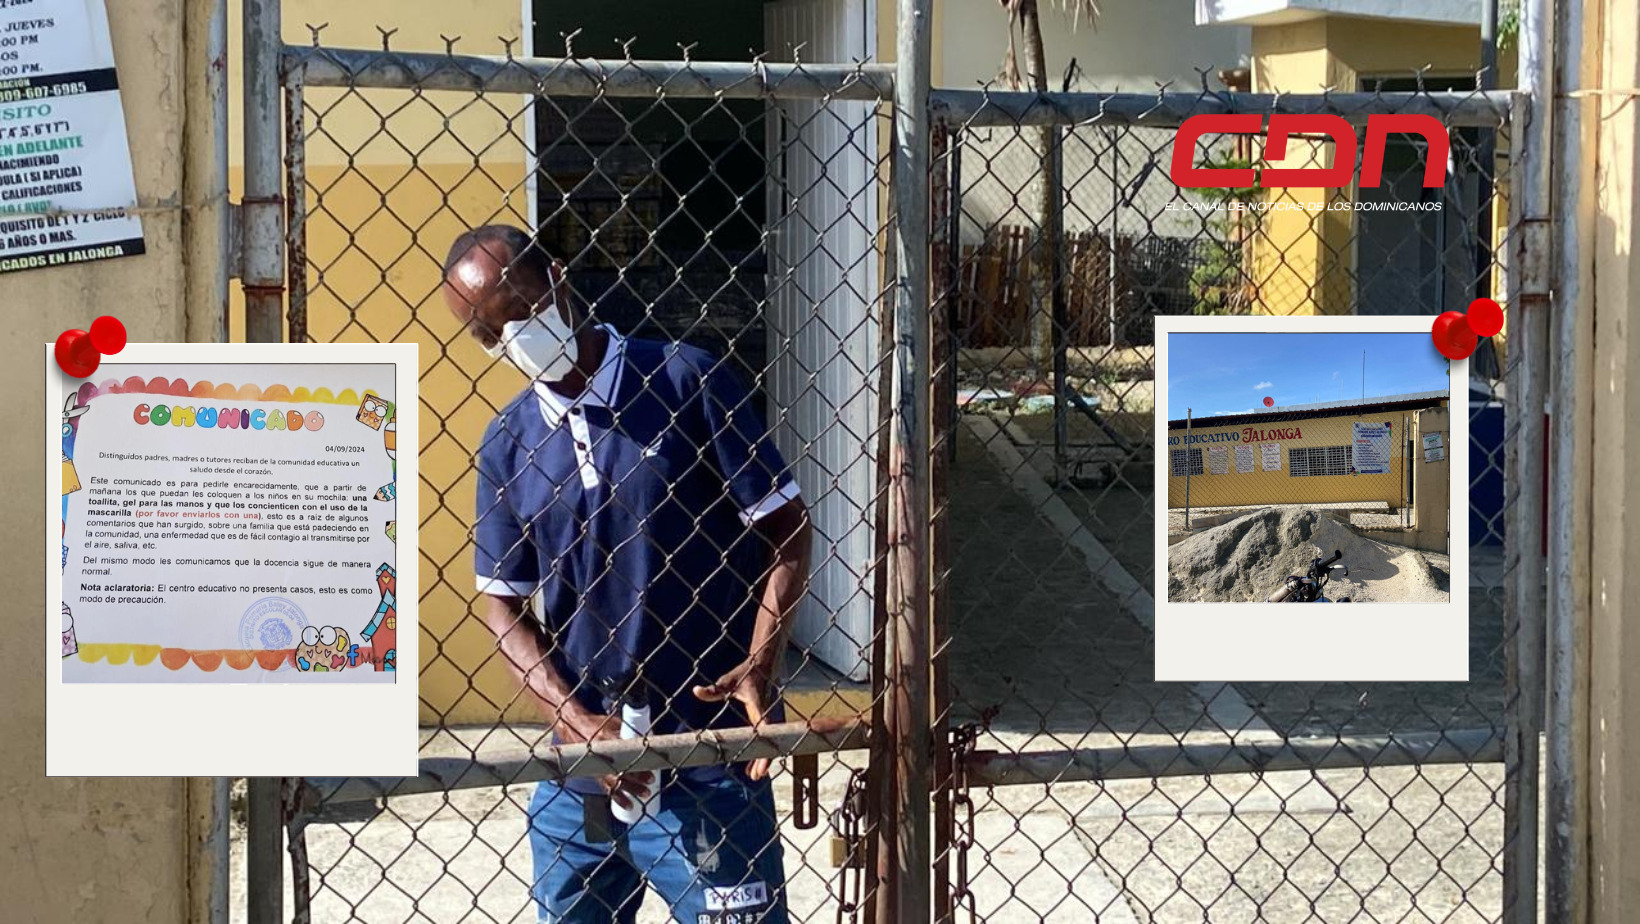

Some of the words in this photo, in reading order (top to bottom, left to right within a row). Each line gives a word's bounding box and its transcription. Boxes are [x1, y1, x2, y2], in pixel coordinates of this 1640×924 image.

[4, 18, 55, 32] JUEVES
[21, 34, 38, 46] PM
[0, 104, 52, 120] SITO
[17, 136, 83, 154] ADELANTE
[31, 171, 41, 182] SI
[43, 166, 82, 180] APLICA)
[2, 182, 83, 201] CALIFICACIONES
[0, 216, 45, 234] QUISITO
[8, 234, 37, 249] AÑOS
[49, 230, 77, 244] MAS.
[0, 255, 46, 272] CADOS
[49, 252, 67, 265] EN
[68, 245, 124, 263] JALONGA
[133, 403, 325, 432] COMUNICADO
[1242, 427, 1303, 443] JALONGA
[325, 445, 365, 453] 04/09/2024
[99, 452, 142, 463] Distinguidos
[171, 454, 198, 462] madres
[206, 455, 232, 463] tutores
[232, 455, 258, 464] reciban
[260, 456, 268, 465] de
[270, 456, 276, 465] la
[278, 457, 315, 466] comunidad
[317, 458, 349, 467] educativa
[190, 466, 212, 474] saludo
[214, 466, 235, 474] desde
[236, 466, 242, 475] el
[90, 476, 108, 485] Este
[113, 477, 162, 486] comunicado
[180, 480, 198, 489] para
[203, 479, 229, 490] pedirle
[304, 484, 318, 492] que
[333, 482, 352, 493] partir
[356, 483, 366, 491] de
[89, 487, 121, 496] mañana
[126, 488, 137, 496] los
[140, 490, 156, 499] que
[160, 489, 189, 499] puedan
[192, 489, 204, 498] les
[206, 490, 242, 500] coloquen
[252, 491, 264, 499] los
[268, 491, 288, 500] niños
[122, 498, 136, 509] gel
[139, 501, 158, 509] para
[160, 499, 173, 507] las
[214, 502, 230, 510] que
[233, 500, 245, 509] los
[248, 501, 301, 510] concienticen
[320, 502, 327, 510] el
[348, 503, 358, 511] de
[360, 503, 368, 511] la
[88, 508, 132, 517] mascarilla
[136, 509, 153, 519] (por
[157, 509, 179, 518] favor
[182, 510, 220, 519] enviarlos
[267, 512, 284, 520] esto
[324, 513, 335, 521] de
[338, 513, 368, 523] algunos
[86, 519, 136, 527] comentarios
[138, 521, 154, 530] que
[156, 520, 172, 528] han
[208, 521, 230, 529] sobre
[250, 521, 274, 530] familia
[276, 524, 291, 532] que
[294, 522, 310, 531] está
[312, 523, 358, 533] padeciendo
[86, 529, 93, 537] la
[161, 530, 209, 539] enfermedad
[210, 533, 226, 541] que
[238, 531, 248, 540] de
[250, 532, 266, 540] fácil
[268, 532, 301, 542] contagio
[302, 532, 309, 541] al
[311, 533, 355, 541] transmitirse
[356, 535, 370, 543] por
[84, 541, 92, 549] el
[142, 541, 157, 549] etc.
[83, 556, 97, 564] Del
[101, 556, 128, 564] mismo
[132, 556, 156, 565] modo
[160, 557, 171, 565] les
[175, 557, 230, 566] comunicamos
[234, 559, 249, 568] que
[254, 558, 260, 566] la
[263, 558, 299, 566] docencia
[303, 558, 324, 569] sigue
[328, 559, 338, 567] de
[82, 567, 112, 575] normal.
[80, 583, 101, 591] Nota
[158, 584, 166, 592] El
[168, 584, 196, 592] centro
[198, 584, 238, 592] educativo
[252, 585, 288, 595] presenta
[319, 585, 336, 593] esto
[79, 594, 103, 603] modo
[105, 594, 116, 603] de
[118, 595, 166, 605] precaución.
